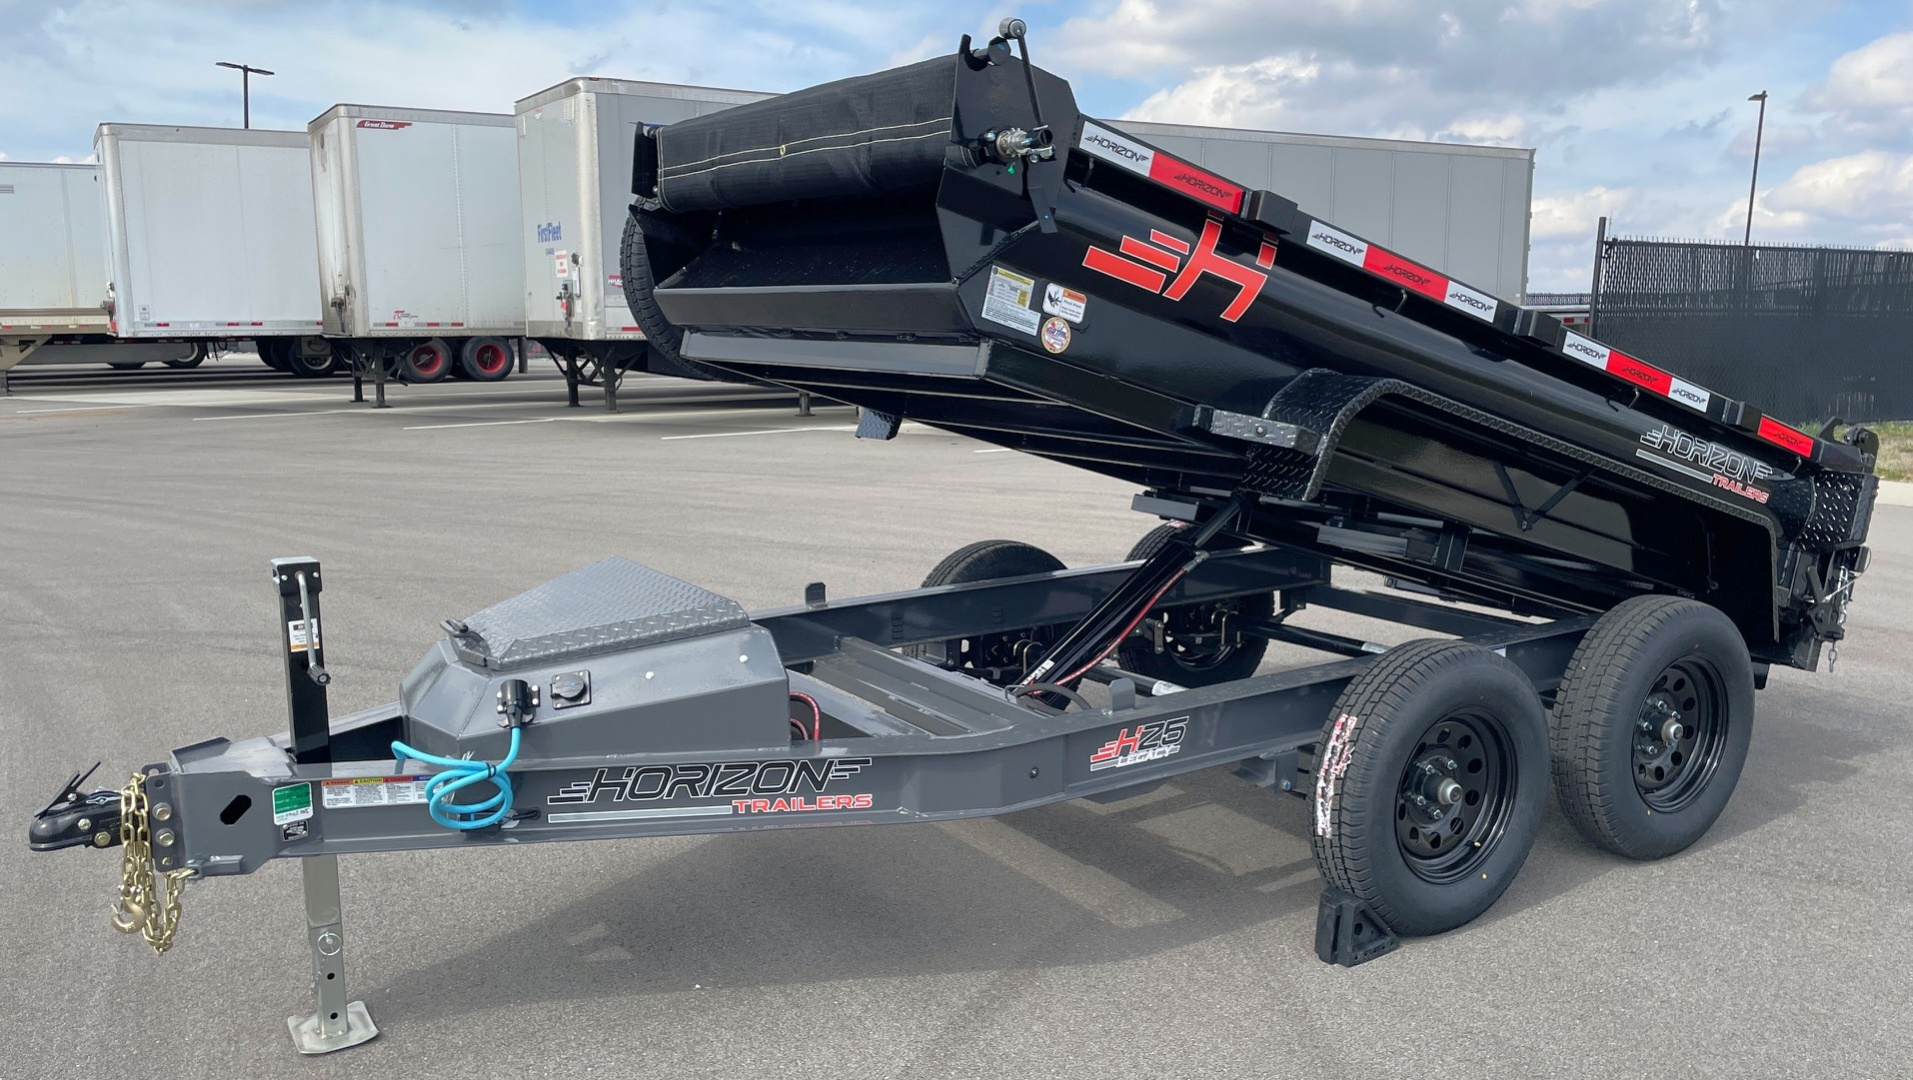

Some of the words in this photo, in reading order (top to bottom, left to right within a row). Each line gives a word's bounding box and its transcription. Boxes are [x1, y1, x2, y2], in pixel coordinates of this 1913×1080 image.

[1092, 134, 1142, 163] HORIZON
[1179, 173, 1227, 199] HORIZON
[537, 221, 562, 243] FirstFleet
[1318, 232, 1359, 256] HORIZON
[1388, 264, 1427, 286] HORIZON
[1454, 291, 1490, 312] HORIZON
[1572, 341, 1602, 360] HORIZON
[1625, 366, 1655, 384] HORIZON
[1676, 388, 1703, 405] HORIZON
[1659, 425, 1759, 485] HORIZON
[1712, 473, 1770, 504] TRAILERS
[1116, 745, 1173, 768] LEGACY
[585, 759, 838, 802] HORIZON
[732, 794, 873, 814] TRAILERS
